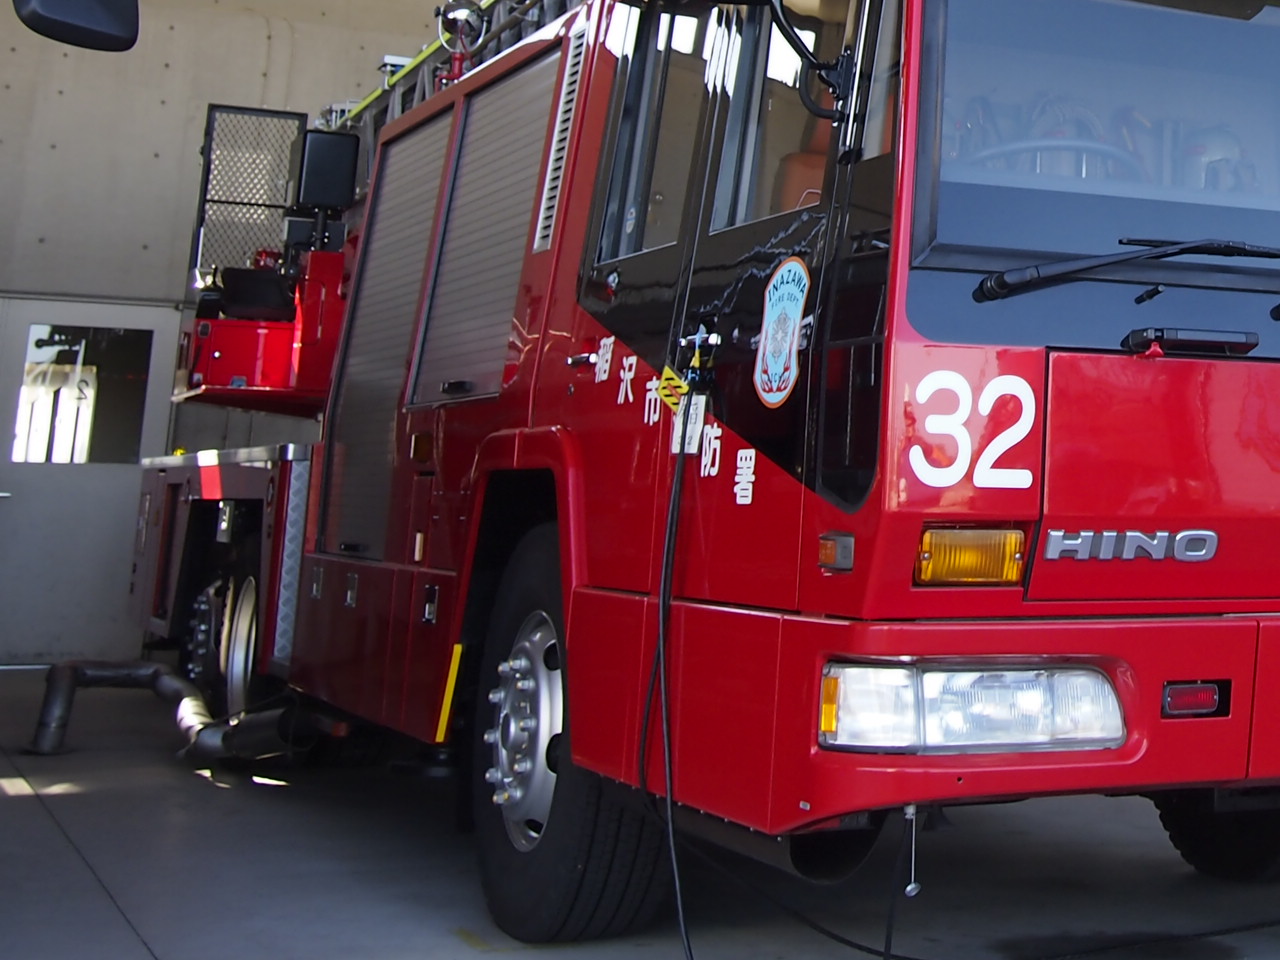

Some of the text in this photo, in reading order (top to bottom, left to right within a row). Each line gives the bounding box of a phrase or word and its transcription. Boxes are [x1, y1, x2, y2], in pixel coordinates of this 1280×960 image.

[768, 269, 806, 302] INAZAWA
[907, 370, 1036, 490] 32
[1044, 529, 1219, 563] HINO
